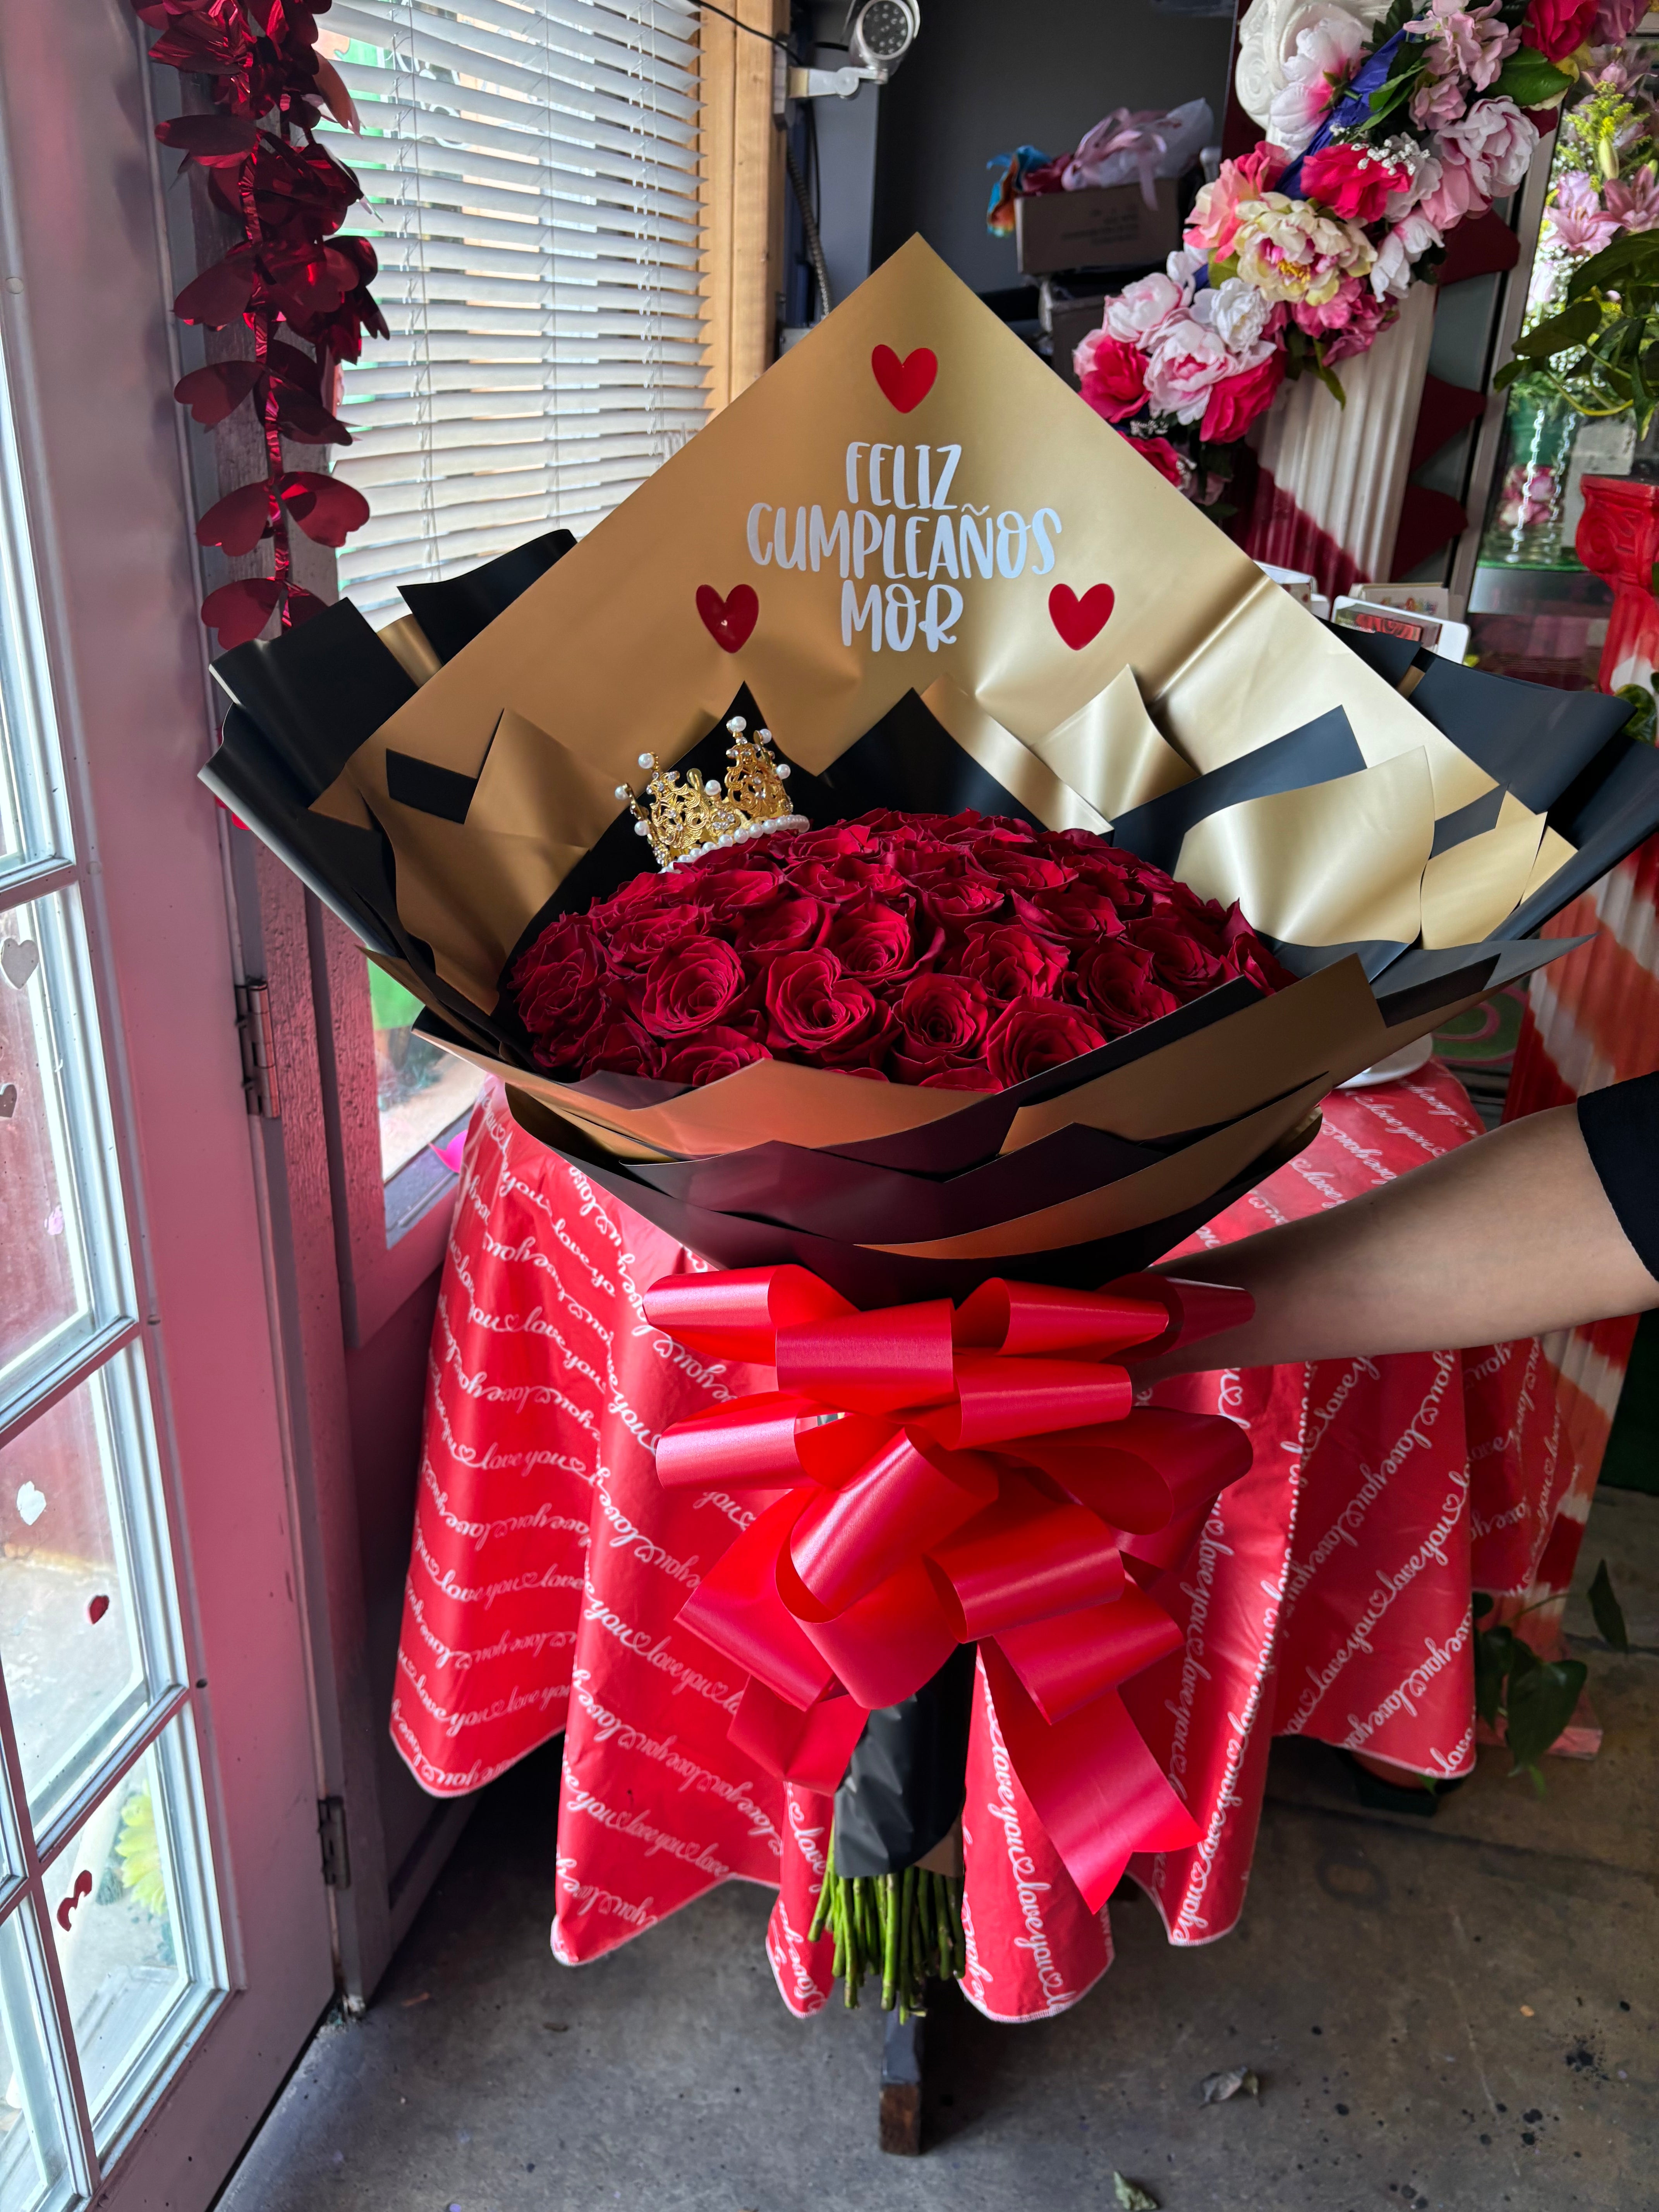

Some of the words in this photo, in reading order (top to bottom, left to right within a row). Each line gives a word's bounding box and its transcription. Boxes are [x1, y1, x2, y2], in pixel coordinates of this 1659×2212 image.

[846, 441, 962, 510] FELIZ
[747, 502, 1062, 580] CUMPLEAÑOS
[841, 579, 964, 653] MOR
[483, 1231, 536, 1262] you
[553, 1218, 589, 1264] love
[591, 1267, 616, 1297] yo
[522, 1306, 566, 1347] love
[562, 1350, 603, 1388] you
[672, 1344, 726, 1388] you
[486, 1385, 531, 1414] love
[607, 1392, 652, 1448] you
[1313, 1372, 1354, 1422] love
[482, 1442, 522, 1470] love
[521, 1450, 567, 1477] you
[1380, 1428, 1432, 1475] love
[1355, 1462, 1388, 1506] you
[445, 1510, 491, 1552] love
[510, 1502, 553, 1531] you
[598, 1492, 639, 1548] love
[653, 1547, 700, 1582] you
[1196, 1542, 1235, 1587] love
[1309, 1523, 1359, 1565] love
[441, 1568, 484, 1602] love
[483, 1577, 521, 1611] you
[1179, 1580, 1211, 1637] you
[1305, 1648, 1351, 1691] love
[1346, 1609, 1379, 1654] you
[1375, 1555, 1425, 1594] love
[1419, 1515, 1455, 1567] you
[419, 1622, 453, 1670] love
[474, 1629, 511, 1663] you
[509, 1632, 548, 1658] love
[583, 1600, 634, 1641] you
[646, 1635, 684, 1678] love
[671, 1666, 714, 1696] you
[1419, 1636, 1452, 1683] you
[1178, 1654, 1212, 1707] love
[416, 1674, 448, 1721] love
[446, 1707, 492, 1738] you
[507, 1685, 538, 1713] love
[1164, 1698, 1191, 1753] you
[1369, 1688, 1419, 1727] love
[578, 1692, 623, 1742] love
[635, 1734, 678, 1762] you
[665, 1752, 705, 1793] love
[709, 1773, 754, 1803] you
[737, 1797, 781, 1836] love
[566, 1789, 617, 1828] you
[622, 1809, 659, 1842] love
[644, 1831, 688, 1859] you
[694, 1842, 730, 1877] love
[794, 1826, 827, 1875] love
[987, 1802, 1026, 1856] you
[1177, 1883, 1209, 1929] you
[1196, 1810, 1228, 1861] love
[1216, 1761, 1243, 1808] you
[1016, 1881, 1052, 1929] love
[1013, 1933, 1055, 1974] you
